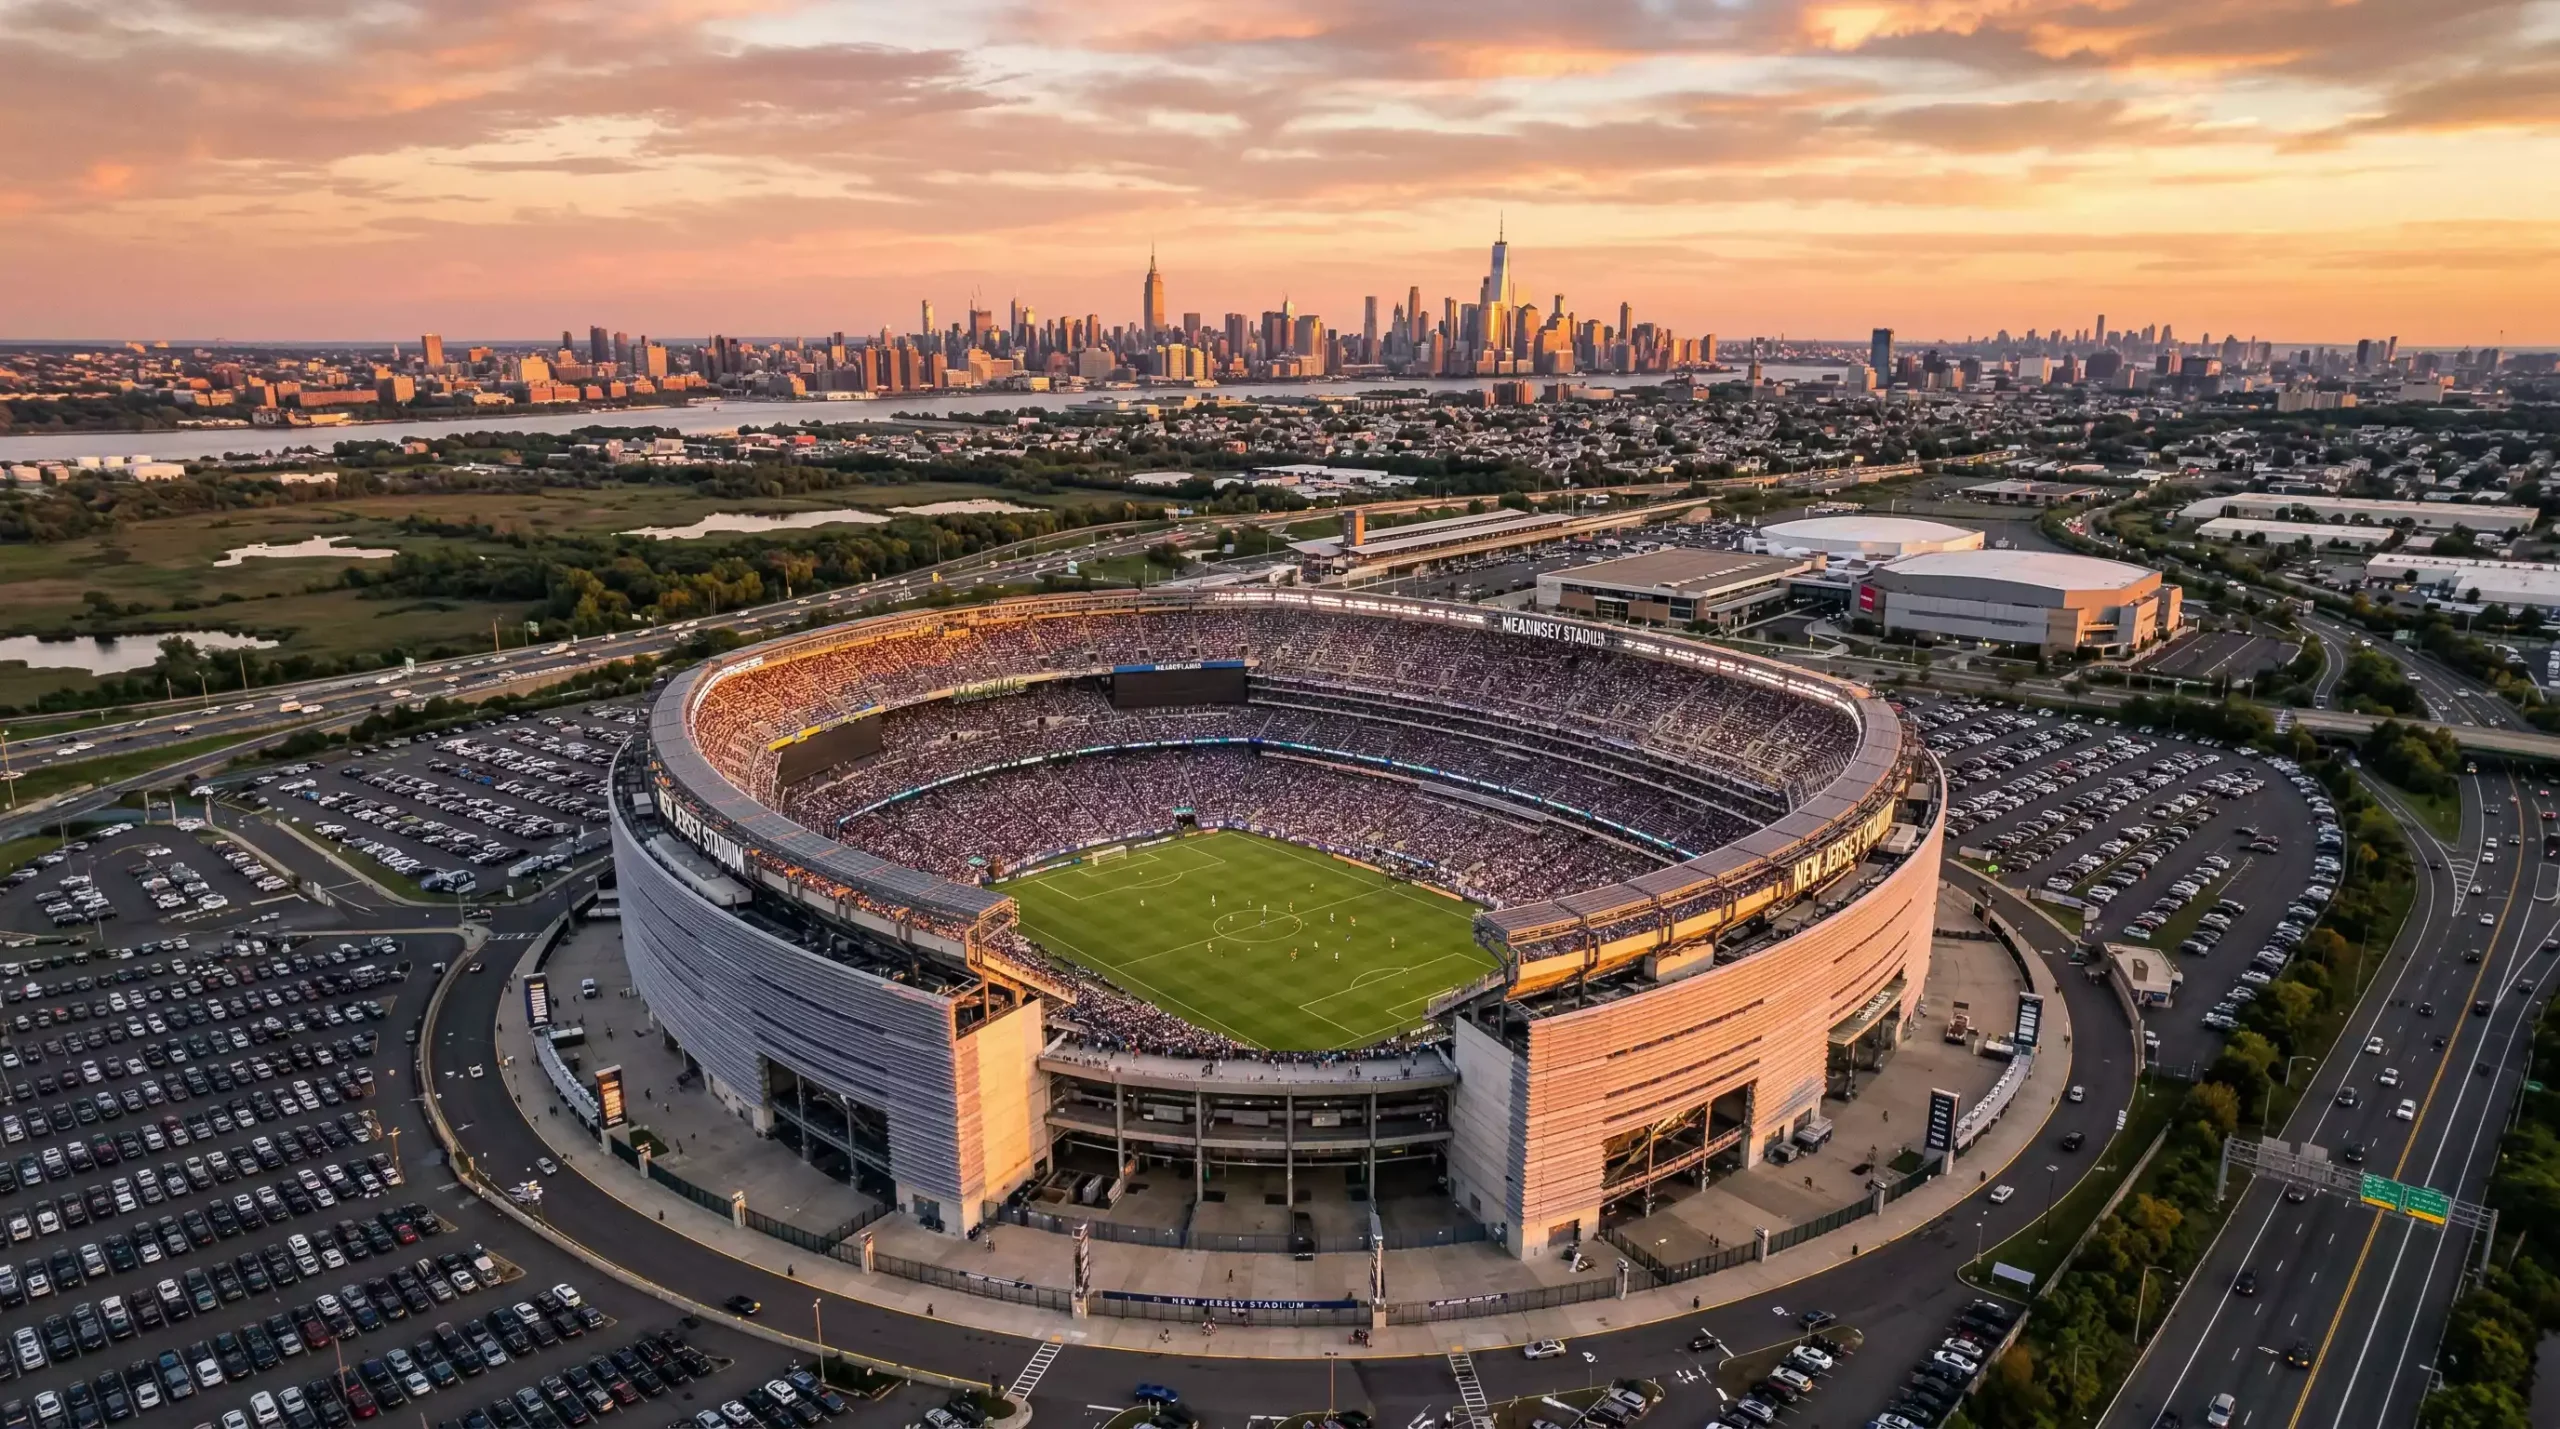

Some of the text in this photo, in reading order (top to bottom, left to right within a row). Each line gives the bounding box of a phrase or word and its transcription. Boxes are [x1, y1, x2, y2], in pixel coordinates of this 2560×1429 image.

[702, 825, 745, 875] STADIUM
[1793, 853, 1822, 893] NEW
[1172, 1297, 1196, 1305] NEW
[1202, 1299, 1246, 1308] JERSEY
